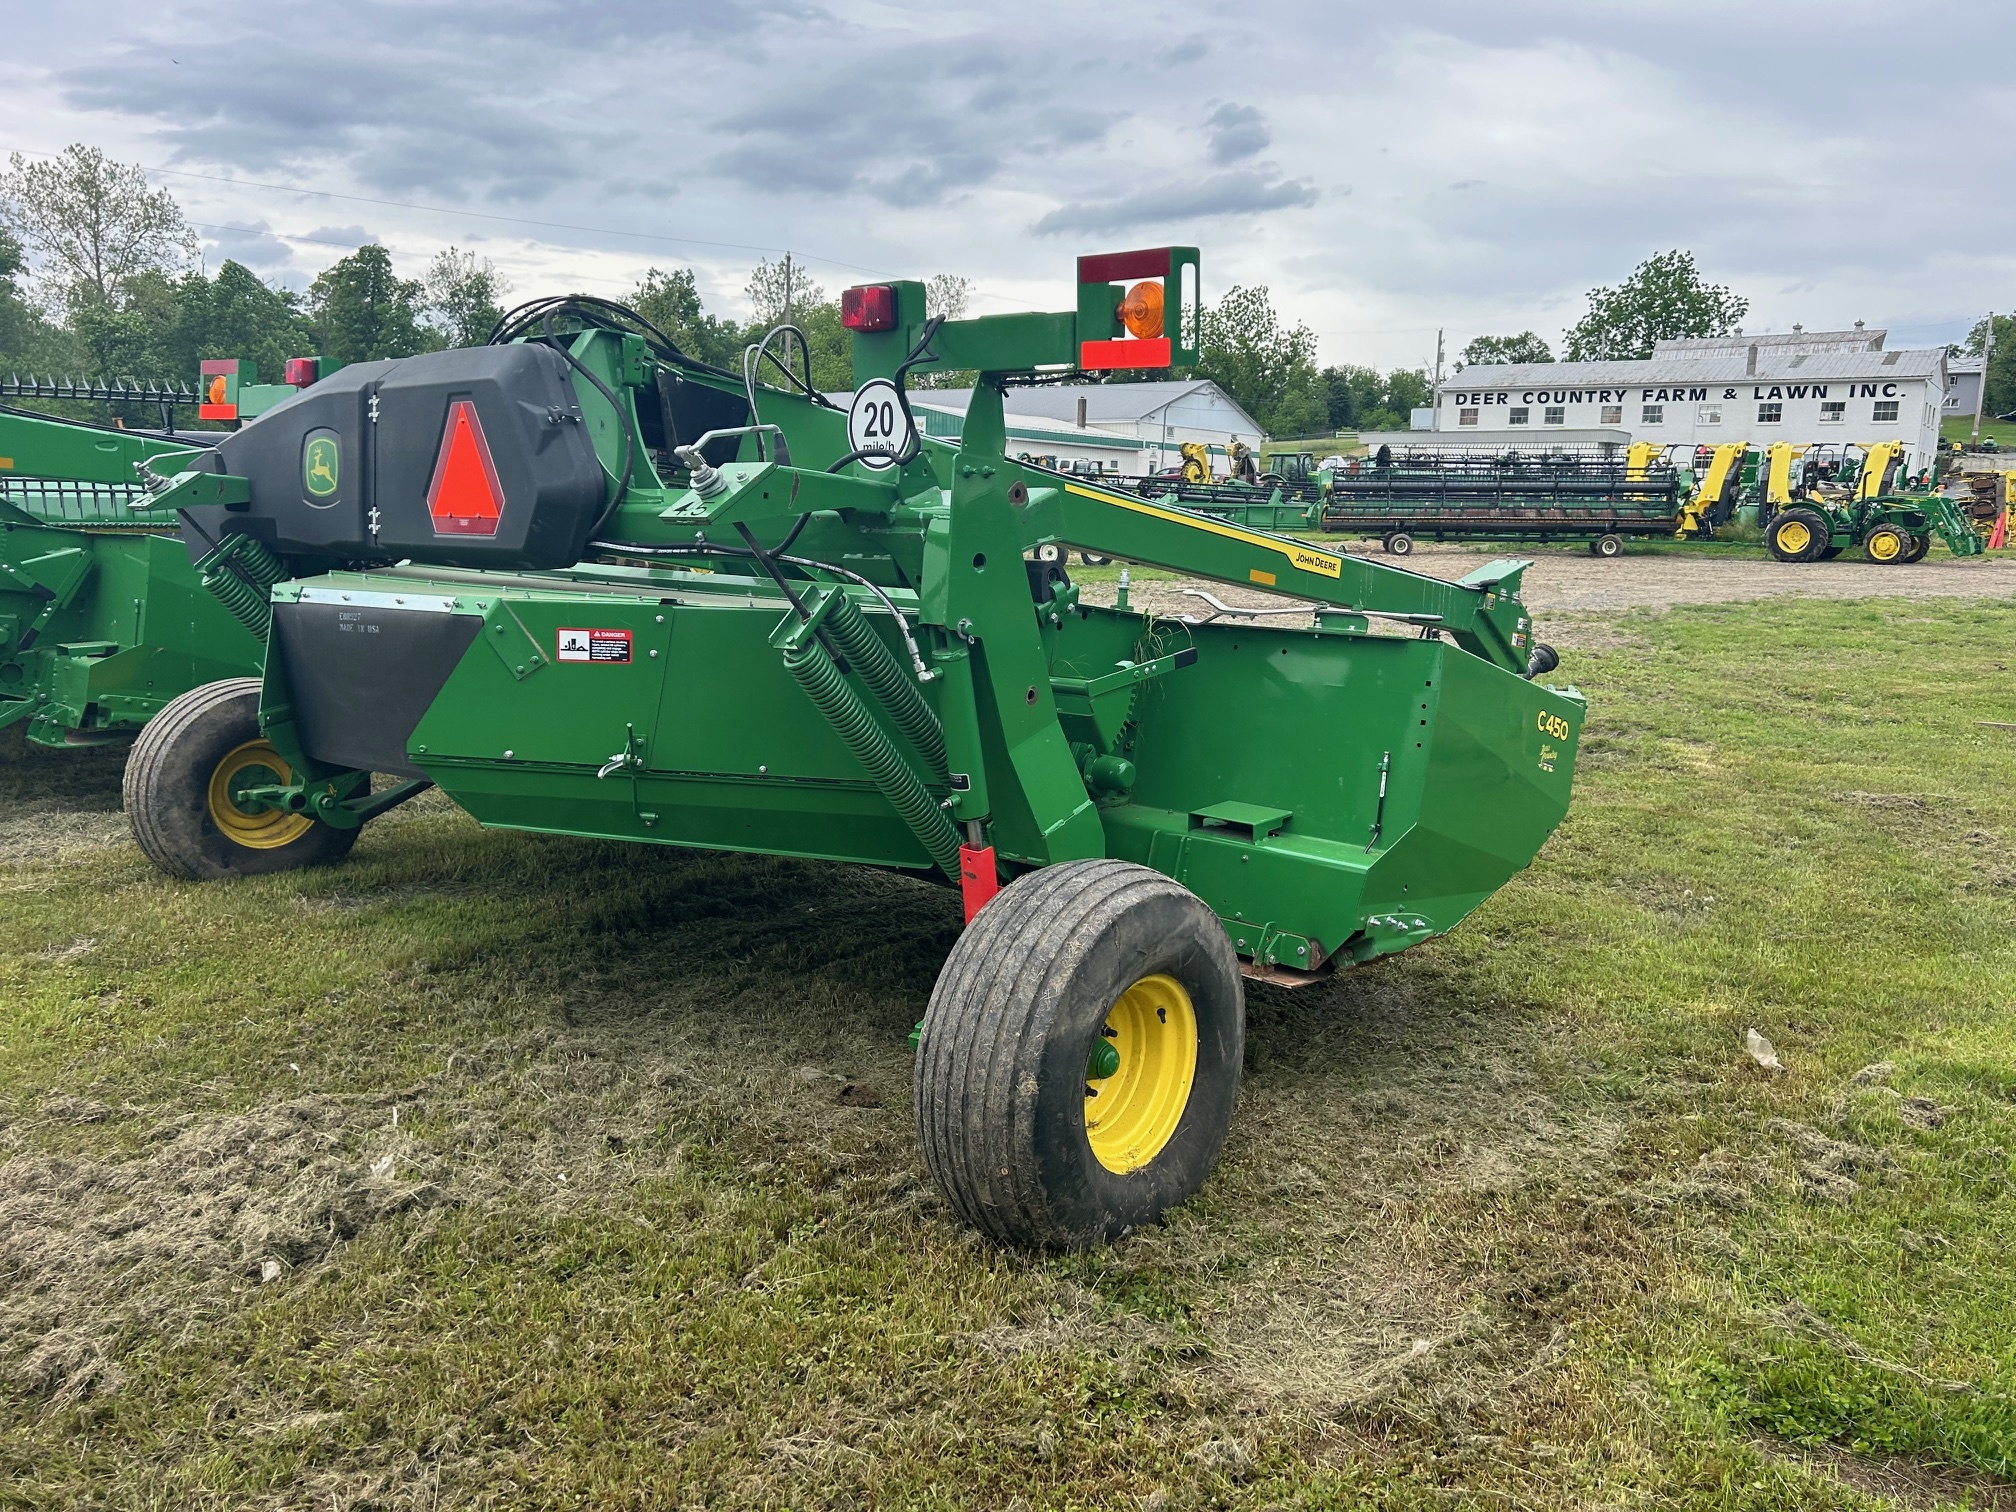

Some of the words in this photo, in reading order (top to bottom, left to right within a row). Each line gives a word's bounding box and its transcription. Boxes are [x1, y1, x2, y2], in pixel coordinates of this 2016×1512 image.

[1455, 392, 1509, 405] DEER
[1522, 389, 1628, 404] COUNTRY
[1641, 387, 1708, 402] FARM
[1722, 388, 1738, 400] &
[1753, 385, 1829, 400] LAWN
[1849, 383, 1907, 398] INC.
[863, 400, 895, 438] 20
[1296, 552, 1315, 565] JOHN
[1315, 557, 1337, 571] DEERE
[339, 623, 354, 632] MADE
[367, 624, 380, 634] USA
